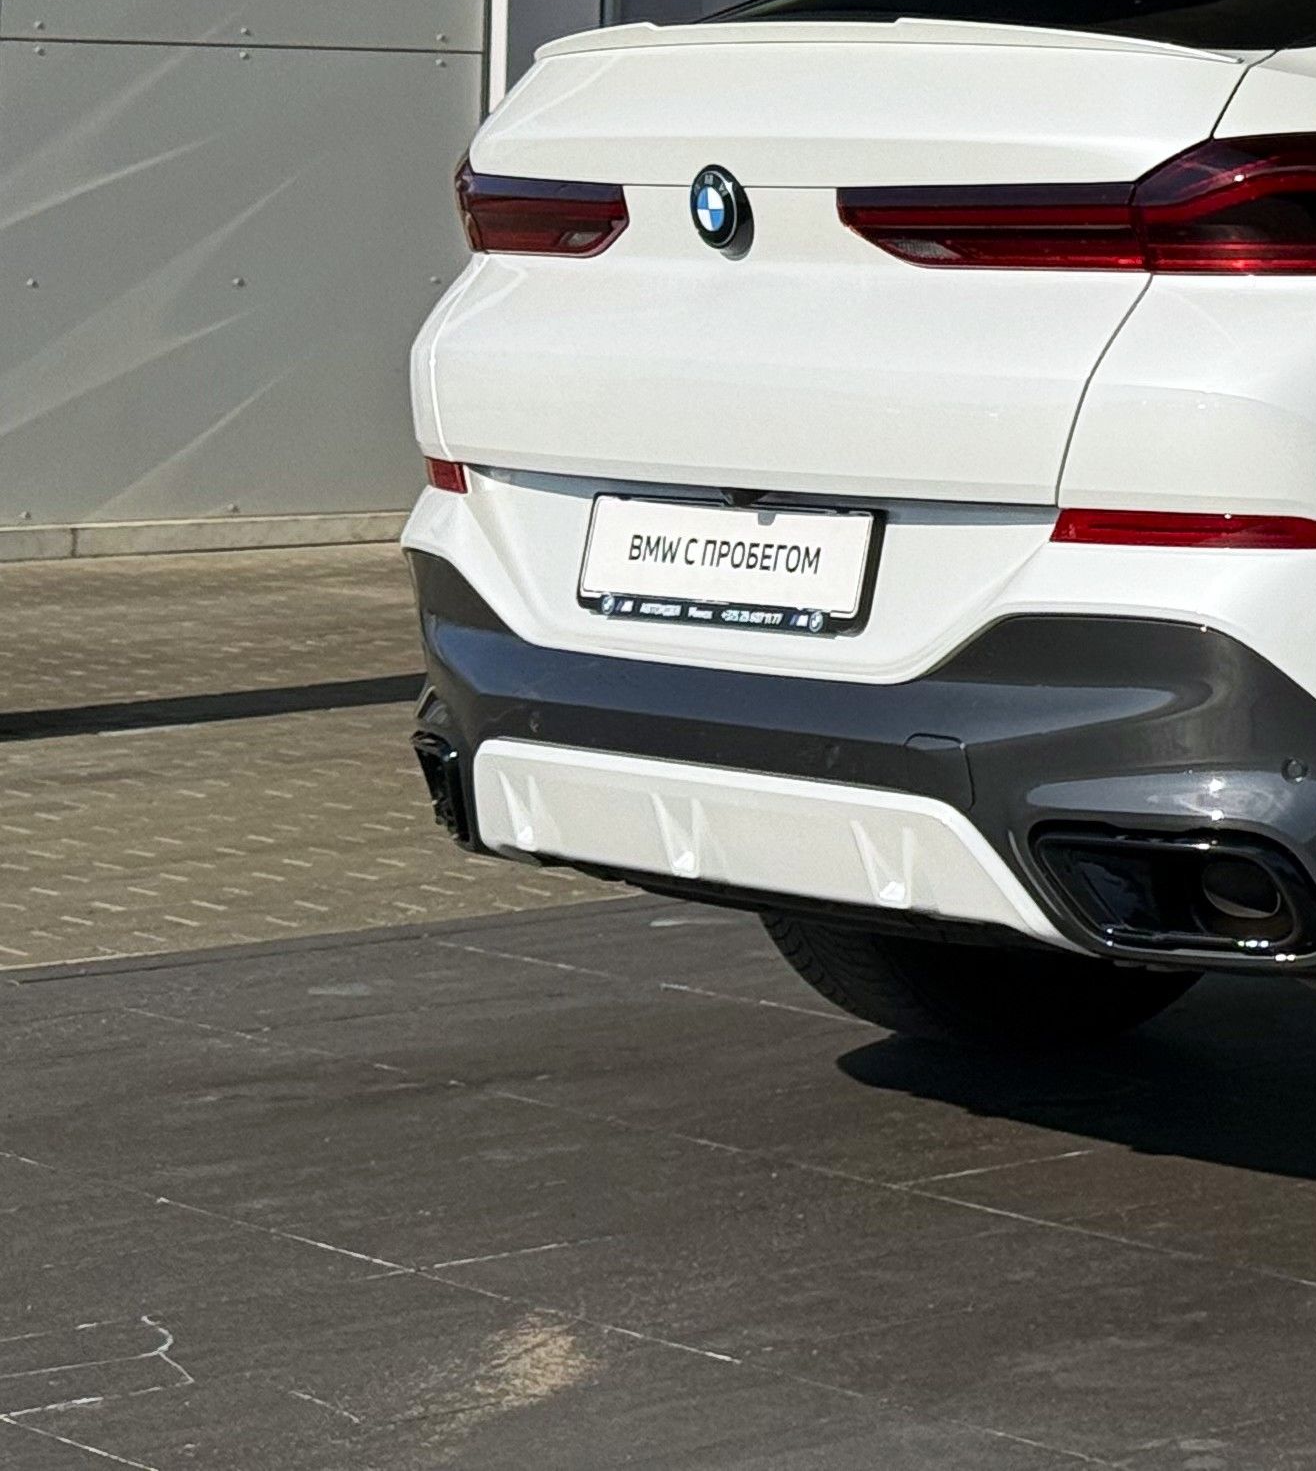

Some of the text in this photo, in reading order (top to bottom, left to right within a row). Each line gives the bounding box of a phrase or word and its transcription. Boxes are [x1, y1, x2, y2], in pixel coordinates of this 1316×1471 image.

[628, 534, 822, 574] BMW С ПРОБЕГОМ
